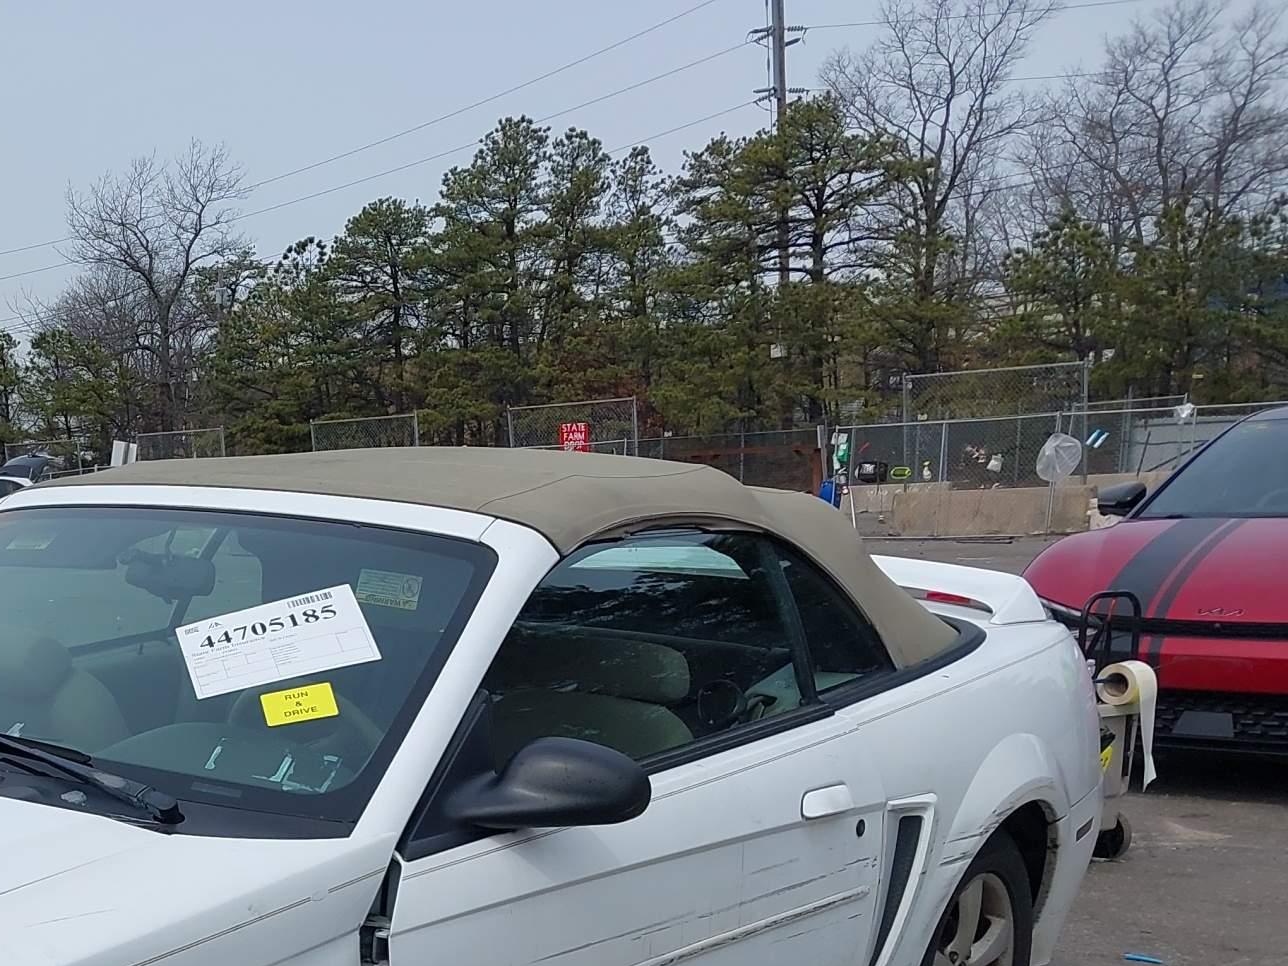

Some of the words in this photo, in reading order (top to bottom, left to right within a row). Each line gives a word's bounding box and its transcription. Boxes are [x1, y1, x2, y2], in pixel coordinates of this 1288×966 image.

[562, 422, 586, 432] STATE
[563, 432, 585, 441] FARM
[199, 604, 338, 649] 44705185
[284, 690, 309, 701] RUN
[283, 705, 319, 718] DRIVE
